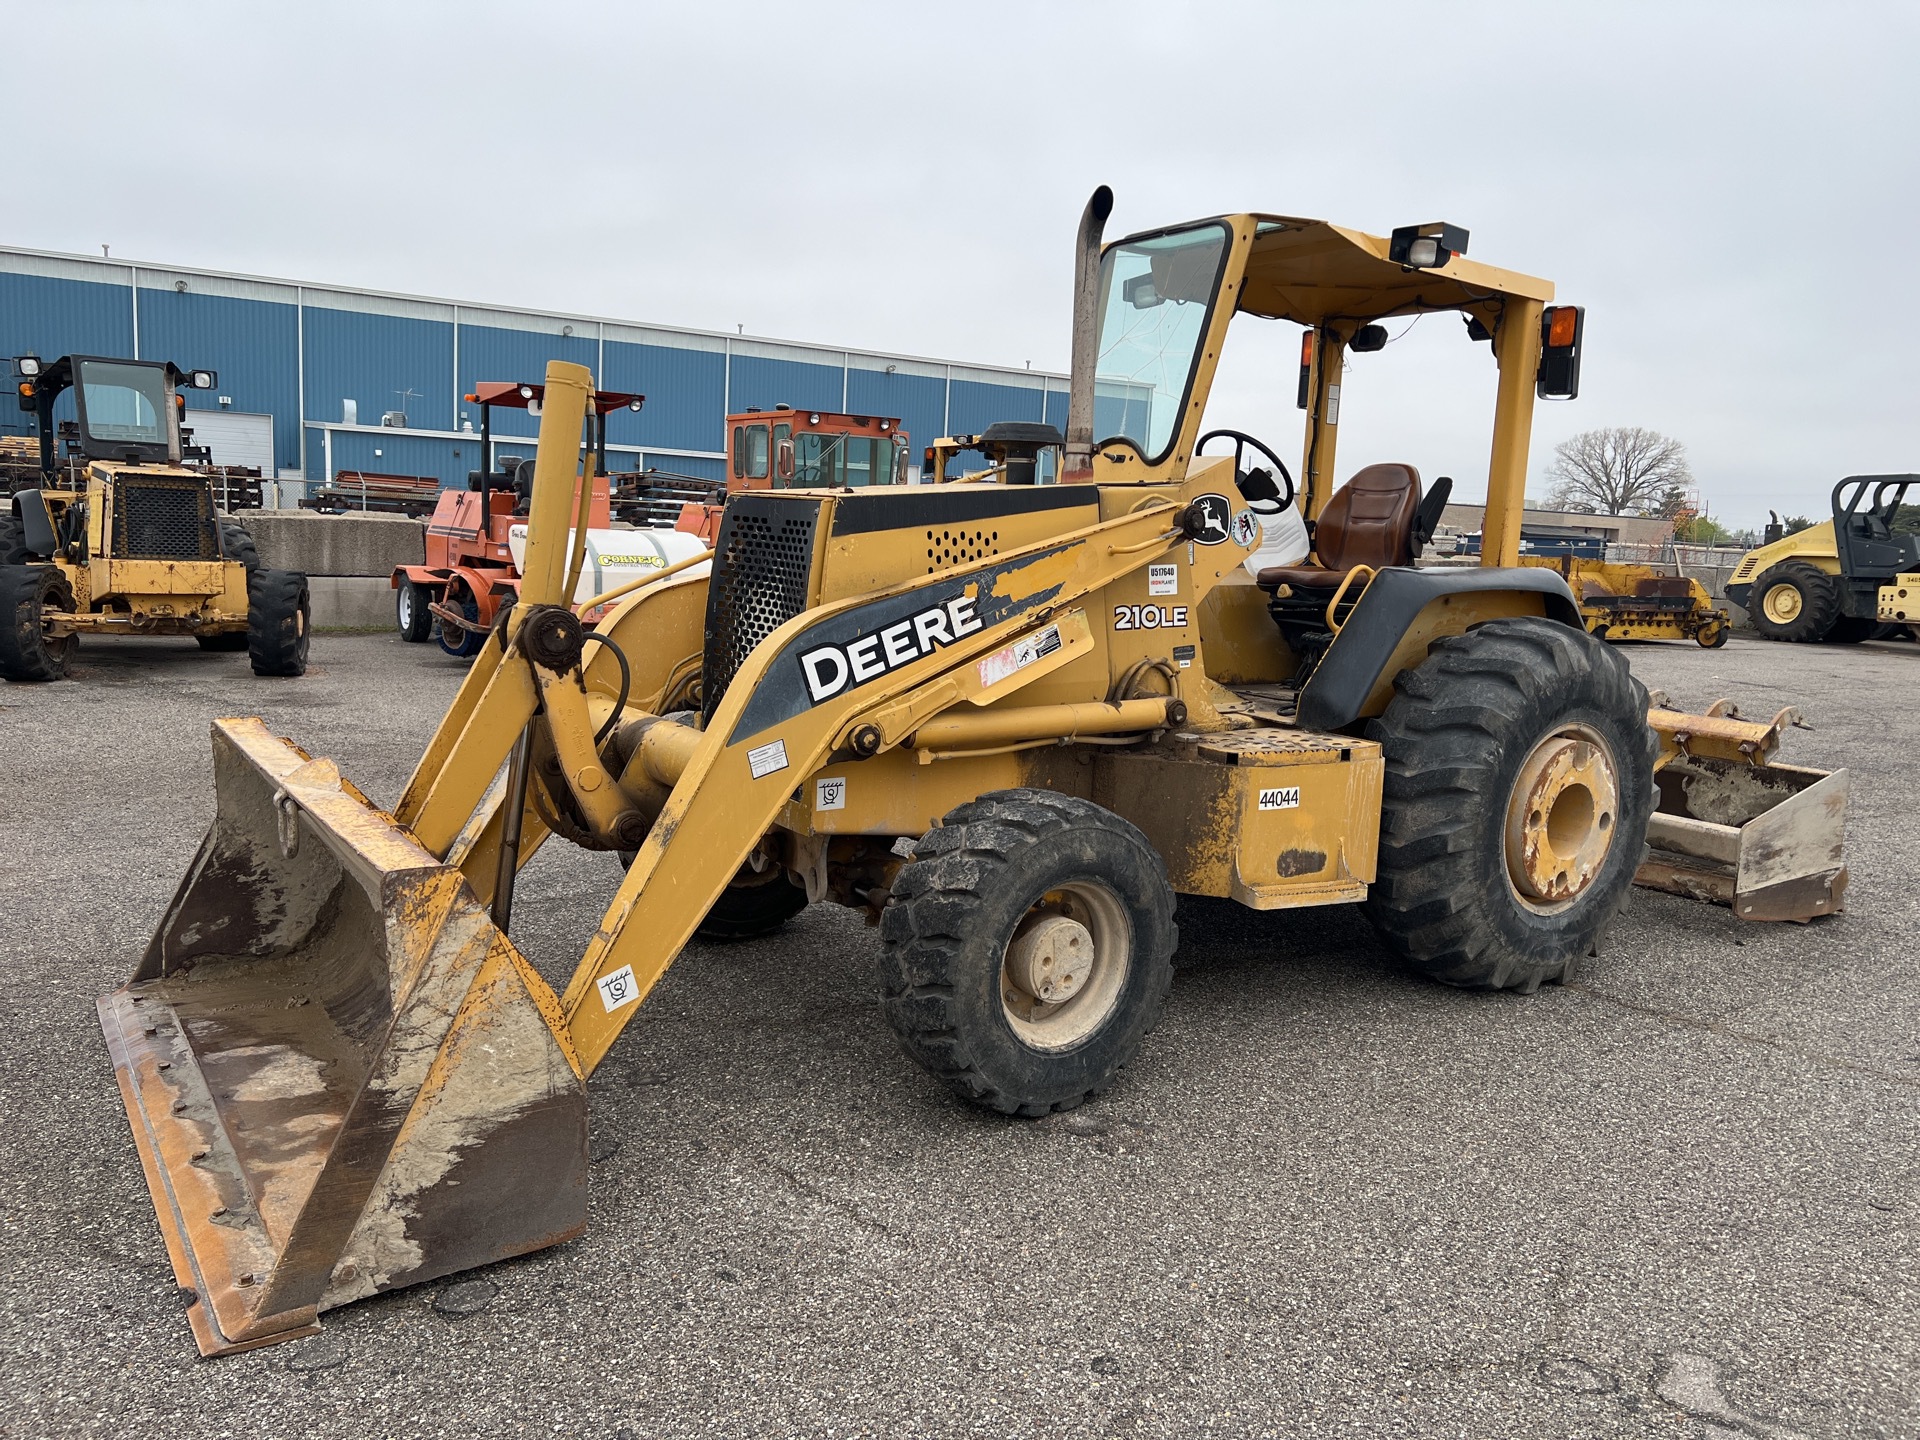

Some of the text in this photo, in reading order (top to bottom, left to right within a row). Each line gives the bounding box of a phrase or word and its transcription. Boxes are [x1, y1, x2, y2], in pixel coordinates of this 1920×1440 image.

[597, 554, 665, 568] CORNEJO
[1150, 567, 1175, 577] U517640
[1115, 604, 1187, 630] 210LE
[801, 596, 983, 702] DEERE
[1259, 789, 1299, 808] 44044
